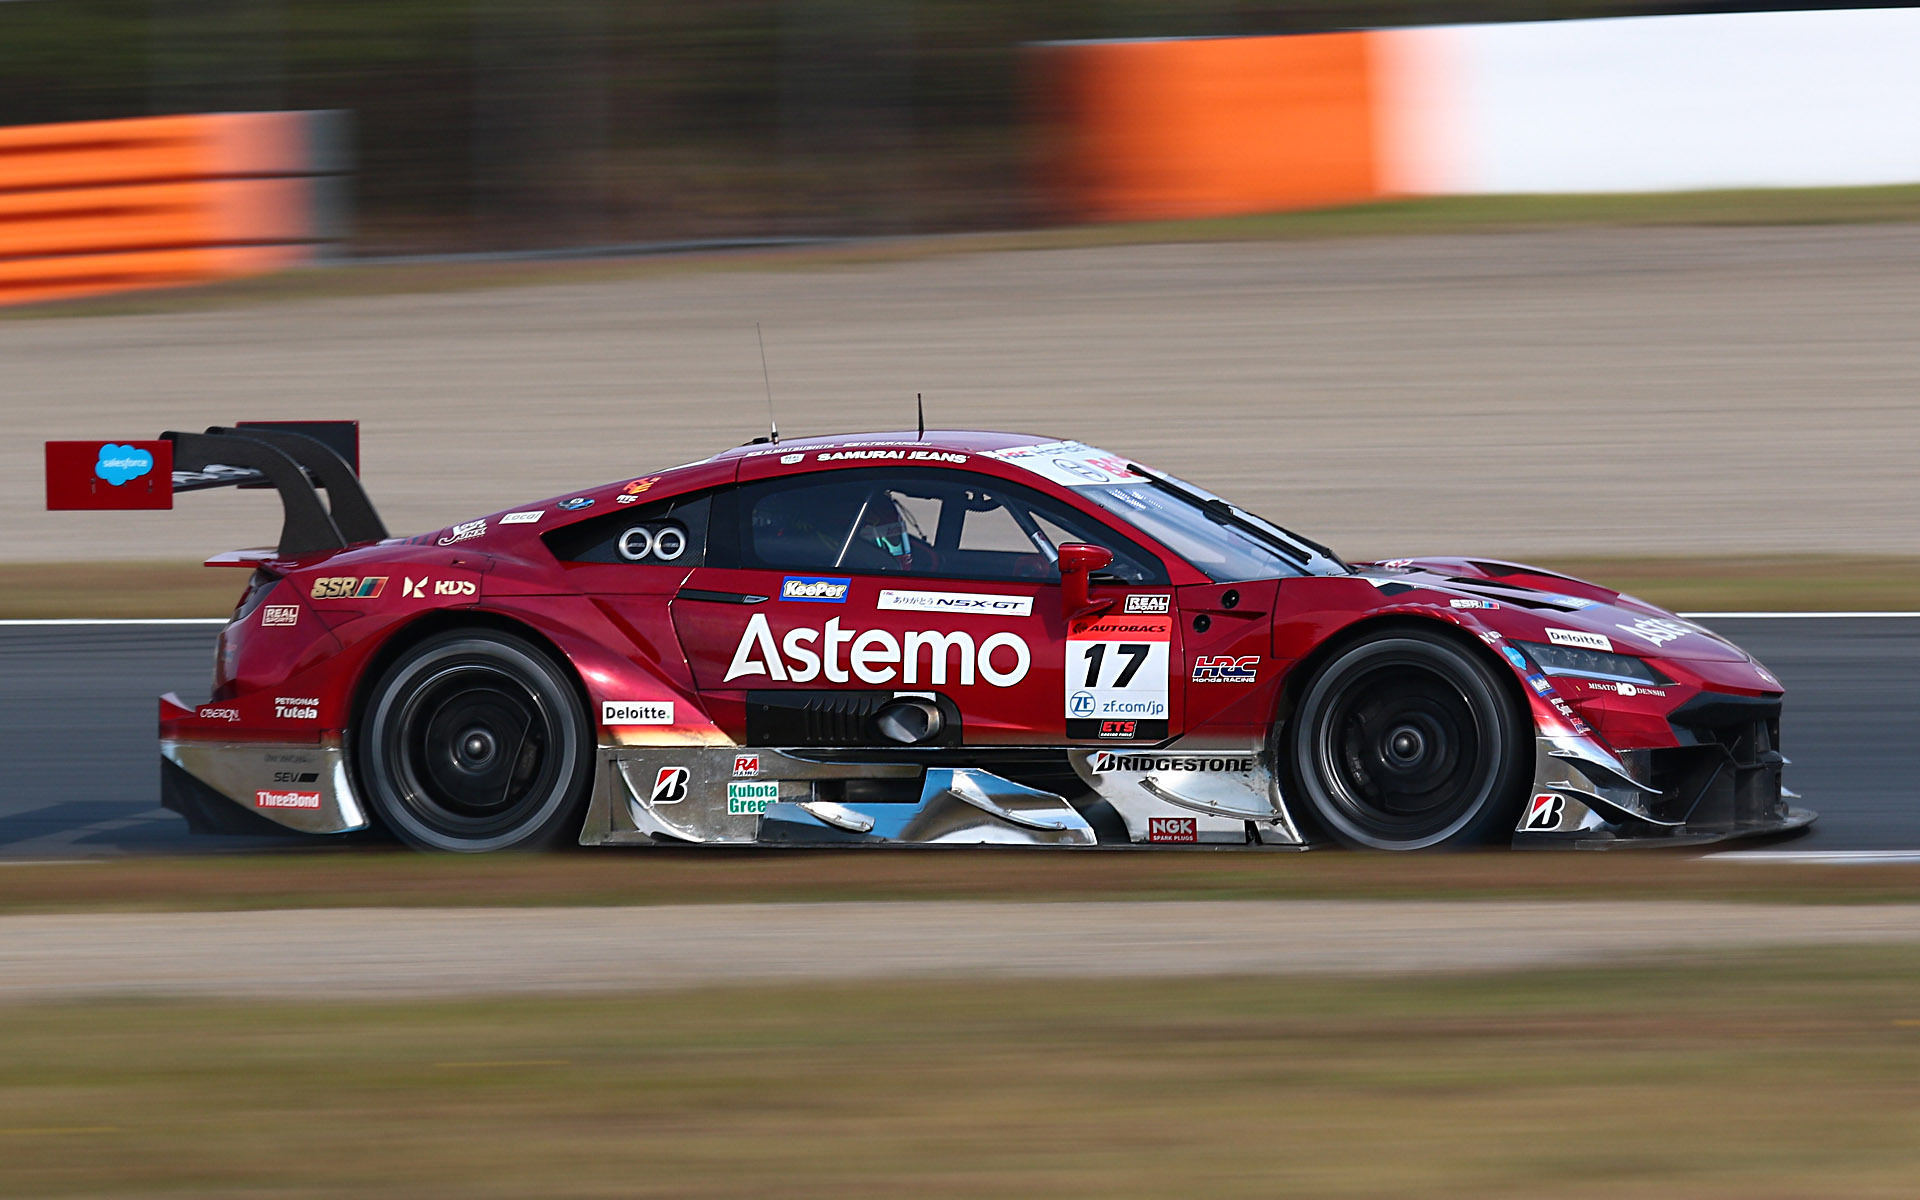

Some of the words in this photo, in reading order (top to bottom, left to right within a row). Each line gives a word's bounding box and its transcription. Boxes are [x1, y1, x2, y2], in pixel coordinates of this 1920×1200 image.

[817, 450, 906, 462] SAMURAI
[103, 458, 148, 470] salesforce
[311, 577, 359, 599] SSR
[784, 581, 847, 599] KeePer
[893, 596, 934, 606] ありがとう
[936, 598, 1026, 611] NSX-GT
[1129, 597, 1167, 606] REAL
[266, 608, 297, 618] REAL
[1088, 624, 1167, 633] AUTOBACS
[723, 613, 1031, 688] Astemo
[1083, 643, 1151, 688] 17
[1192, 655, 1261, 678] HRC
[1587, 682, 1616, 692] MISATO
[274, 697, 320, 706] PETRONAS
[1102, 700, 1165, 715] zf.com/jp
[274, 706, 318, 719] Tutela
[1102, 721, 1136, 733] ETS
[734, 758, 758, 772] RA
[1094, 752, 1253, 774] BRIDGESTONE
[273, 772, 300, 782] SEV
[729, 784, 778, 798] Kubota
[257, 791, 320, 808] ThreeBond
[729, 797, 777, 814] Gree
[1152, 819, 1193, 835] NGK
